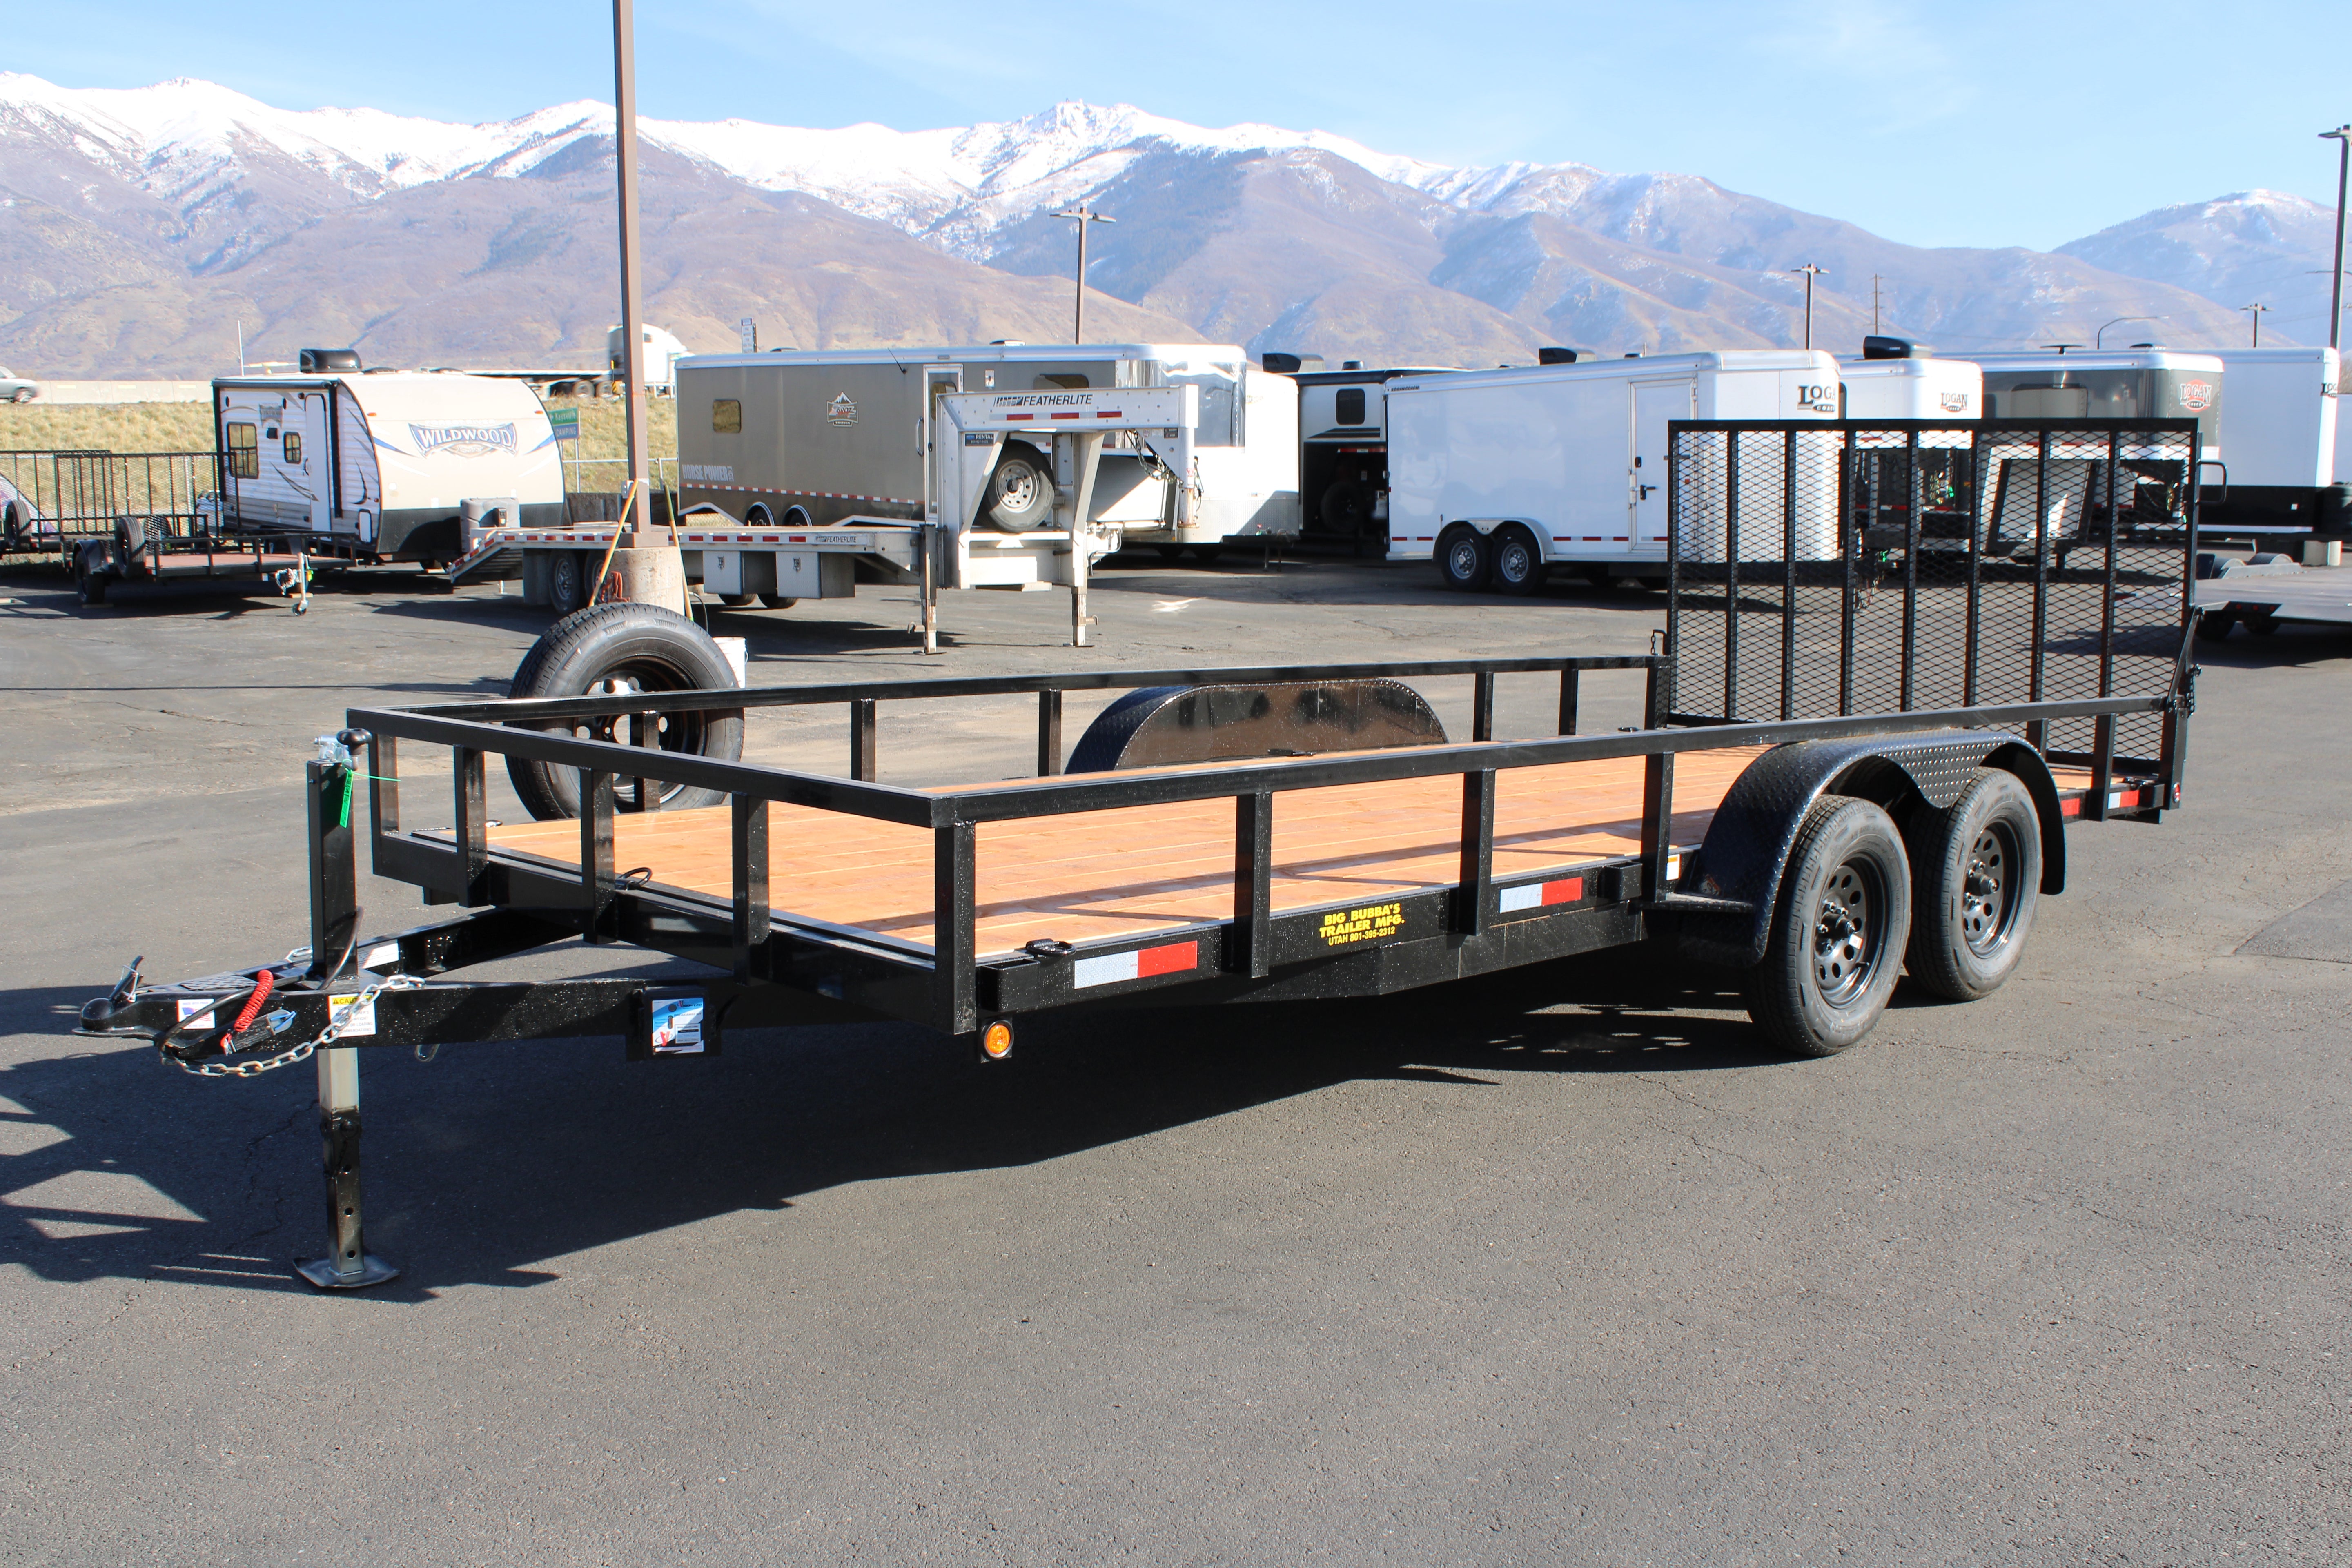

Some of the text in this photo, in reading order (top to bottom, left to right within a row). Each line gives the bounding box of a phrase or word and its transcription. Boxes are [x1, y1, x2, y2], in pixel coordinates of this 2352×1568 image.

[1023, 394, 1093, 406] FEATHERLITE
[1940, 392, 1968, 408] LOGAN
[2180, 383, 2212, 404] LOGAN
[417, 428, 512, 449] WILDWOOD
[682, 464, 704, 480] HORSE
[704, 465, 728, 481] POWER
[1324, 902, 1401, 926] BIG BUBBA'S
[1319, 913, 1405, 938] TRAILER MFG.
[1328, 926, 1396, 946] UTAH 801-395-2312
